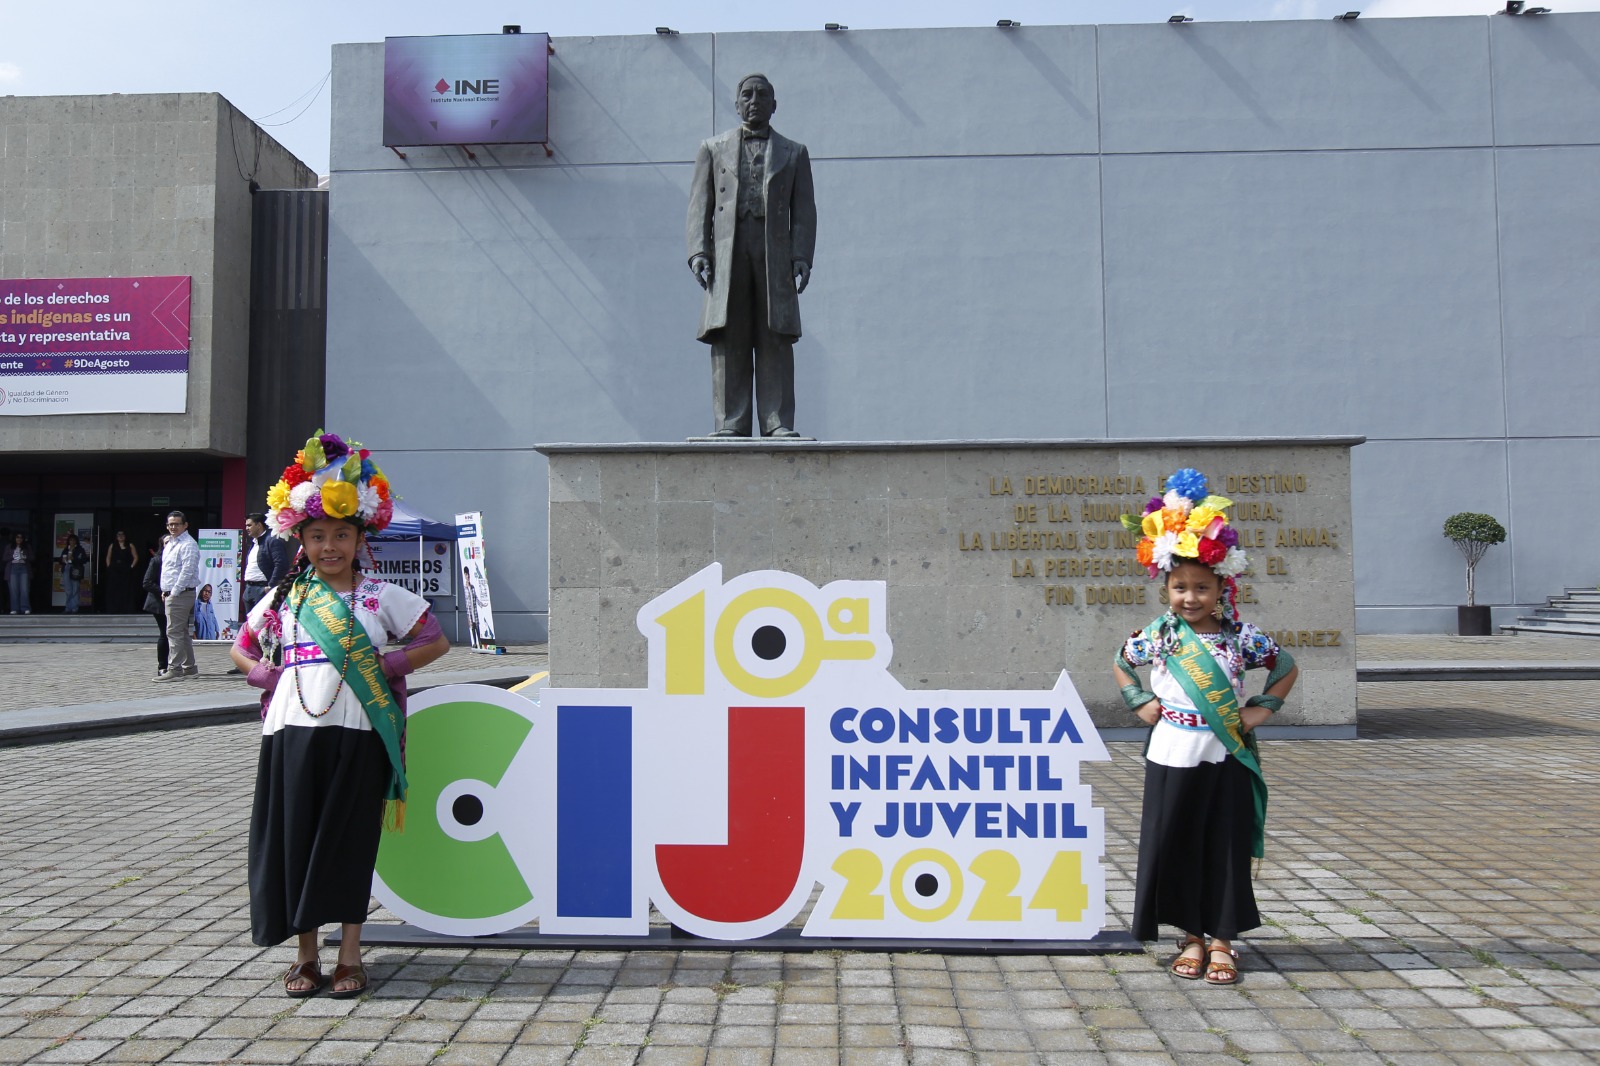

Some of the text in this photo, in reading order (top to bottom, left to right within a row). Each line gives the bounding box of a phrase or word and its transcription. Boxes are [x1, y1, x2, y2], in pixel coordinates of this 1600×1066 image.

[455, 79, 499, 95] INE
[4, 291, 110, 305] de los derechos
[11, 309, 92, 327] indígenas
[95, 312, 110, 322] es
[114, 311, 131, 322] un
[19, 333, 27, 346] y
[30, 329, 131, 345] representativa
[64, 359, 130, 370] #9DeAgosto
[989, 475, 1013, 495] LA
[1024, 475, 1146, 496] DEMOCRACIA
[1226, 473, 1307, 494] DESTINO
[1014, 503, 1037, 523] DE
[1047, 503, 1072, 523] LA
[959, 531, 984, 551] LA
[990, 530, 1082, 553] LIBERTAD,
[1084, 530, 1109, 550] SU
[205, 557, 223, 568] CIJ
[1011, 558, 1036, 578] LA
[1044, 558, 1152, 578] PERFECCIO
[1266, 555, 1288, 575] EL
[1044, 585, 1075, 606] FIN
[1085, 585, 1147, 605] DONDE
[338, 633, 366, 649] de
[349, 645, 372, 662] la
[357, 653, 391, 709] Chinampa
[1205, 687, 1230, 704] de
[1216, 699, 1236, 717] la
[829, 707, 1084, 744] CONSULTA
[831, 754, 1063, 791] INFANTIL
[373, 701, 806, 923] CIJ
[829, 802, 1088, 839] Y JUVENIL
[829, 847, 1089, 922] 2024
